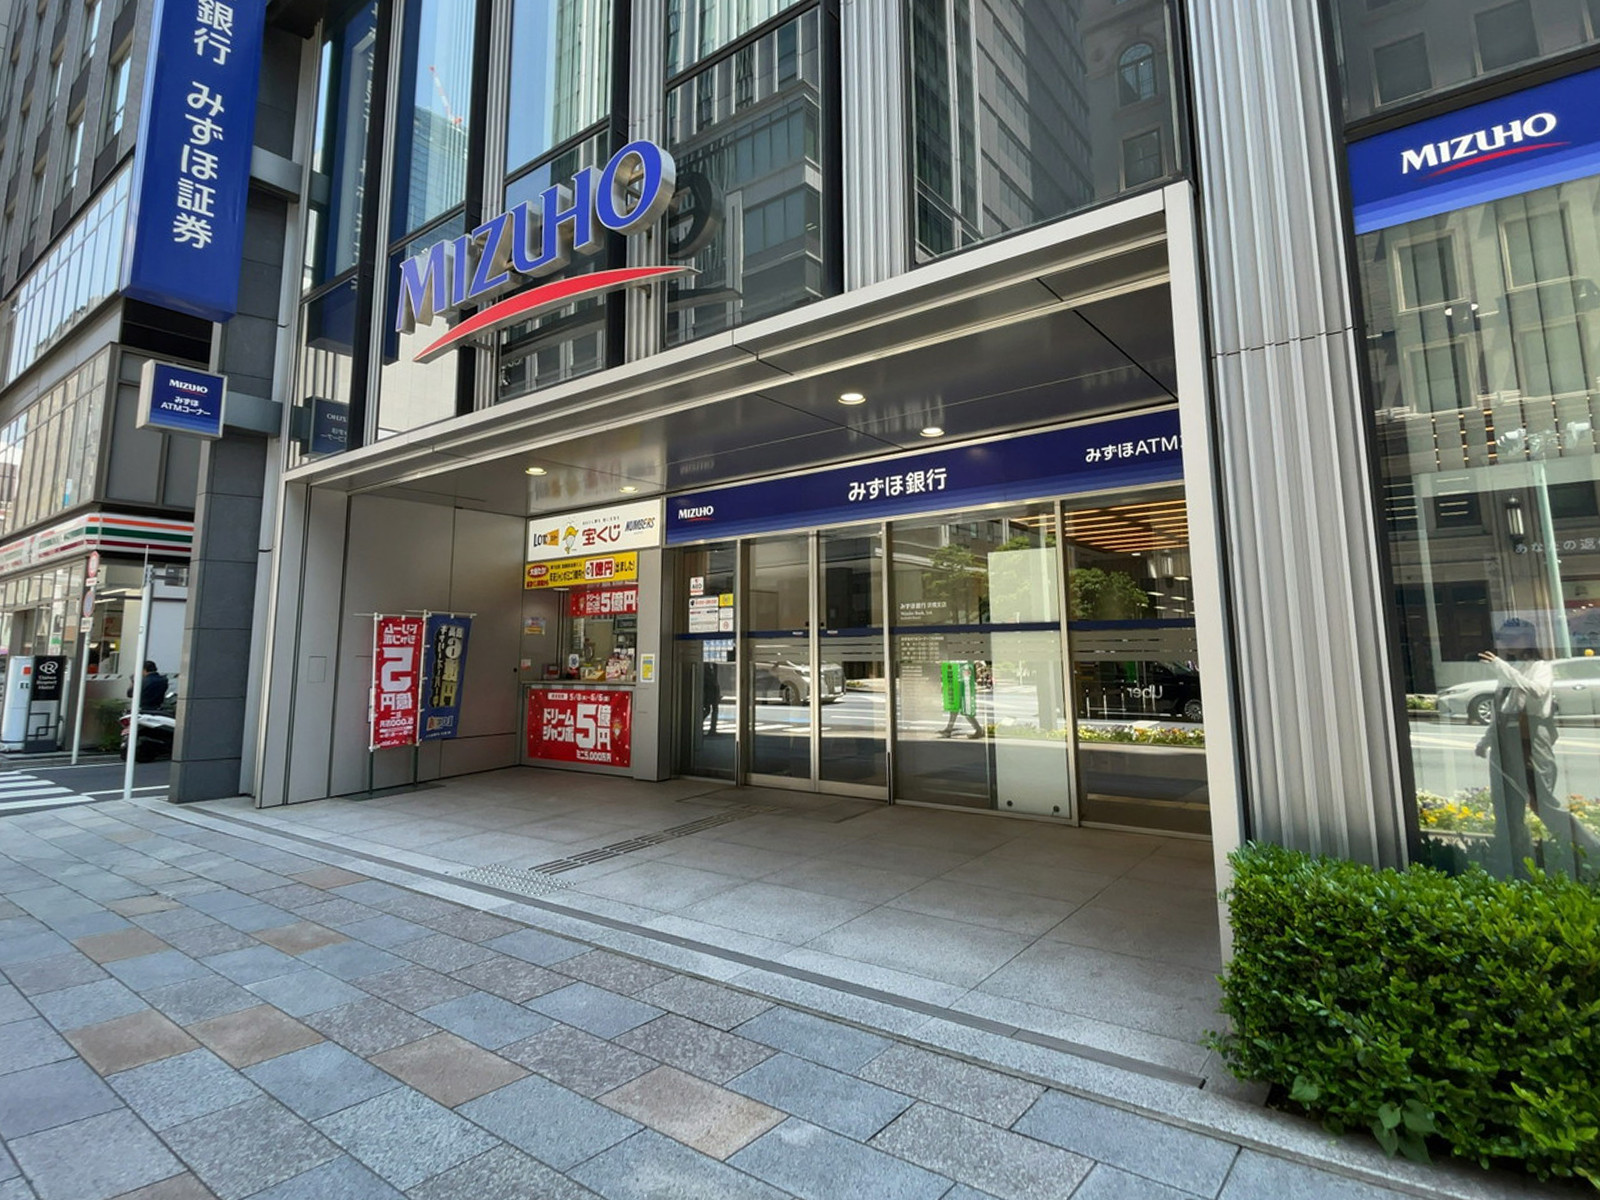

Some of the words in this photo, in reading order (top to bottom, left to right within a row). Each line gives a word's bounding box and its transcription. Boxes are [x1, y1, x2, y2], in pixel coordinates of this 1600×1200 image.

[1401, 111, 1558, 175] MIZUHO
[173, 81, 225, 250] みずほ証券
[396, 139, 677, 335] MIZUHO
[169, 379, 209, 394] MIZUHO
[160, 401, 212, 416] ATMコーナー
[174, 396, 200, 407] みずほ
[1085, 434, 1184, 463] みずほATM
[848, 467, 948, 502] みずほ銀行
[678, 505, 715, 521] MIZUHO
[625, 517, 656, 533] NUMBERS
[582, 524, 621, 546] 宝くじ
[543, 708, 574, 726] ドリーム
[542, 725, 575, 742] ジャンボ
